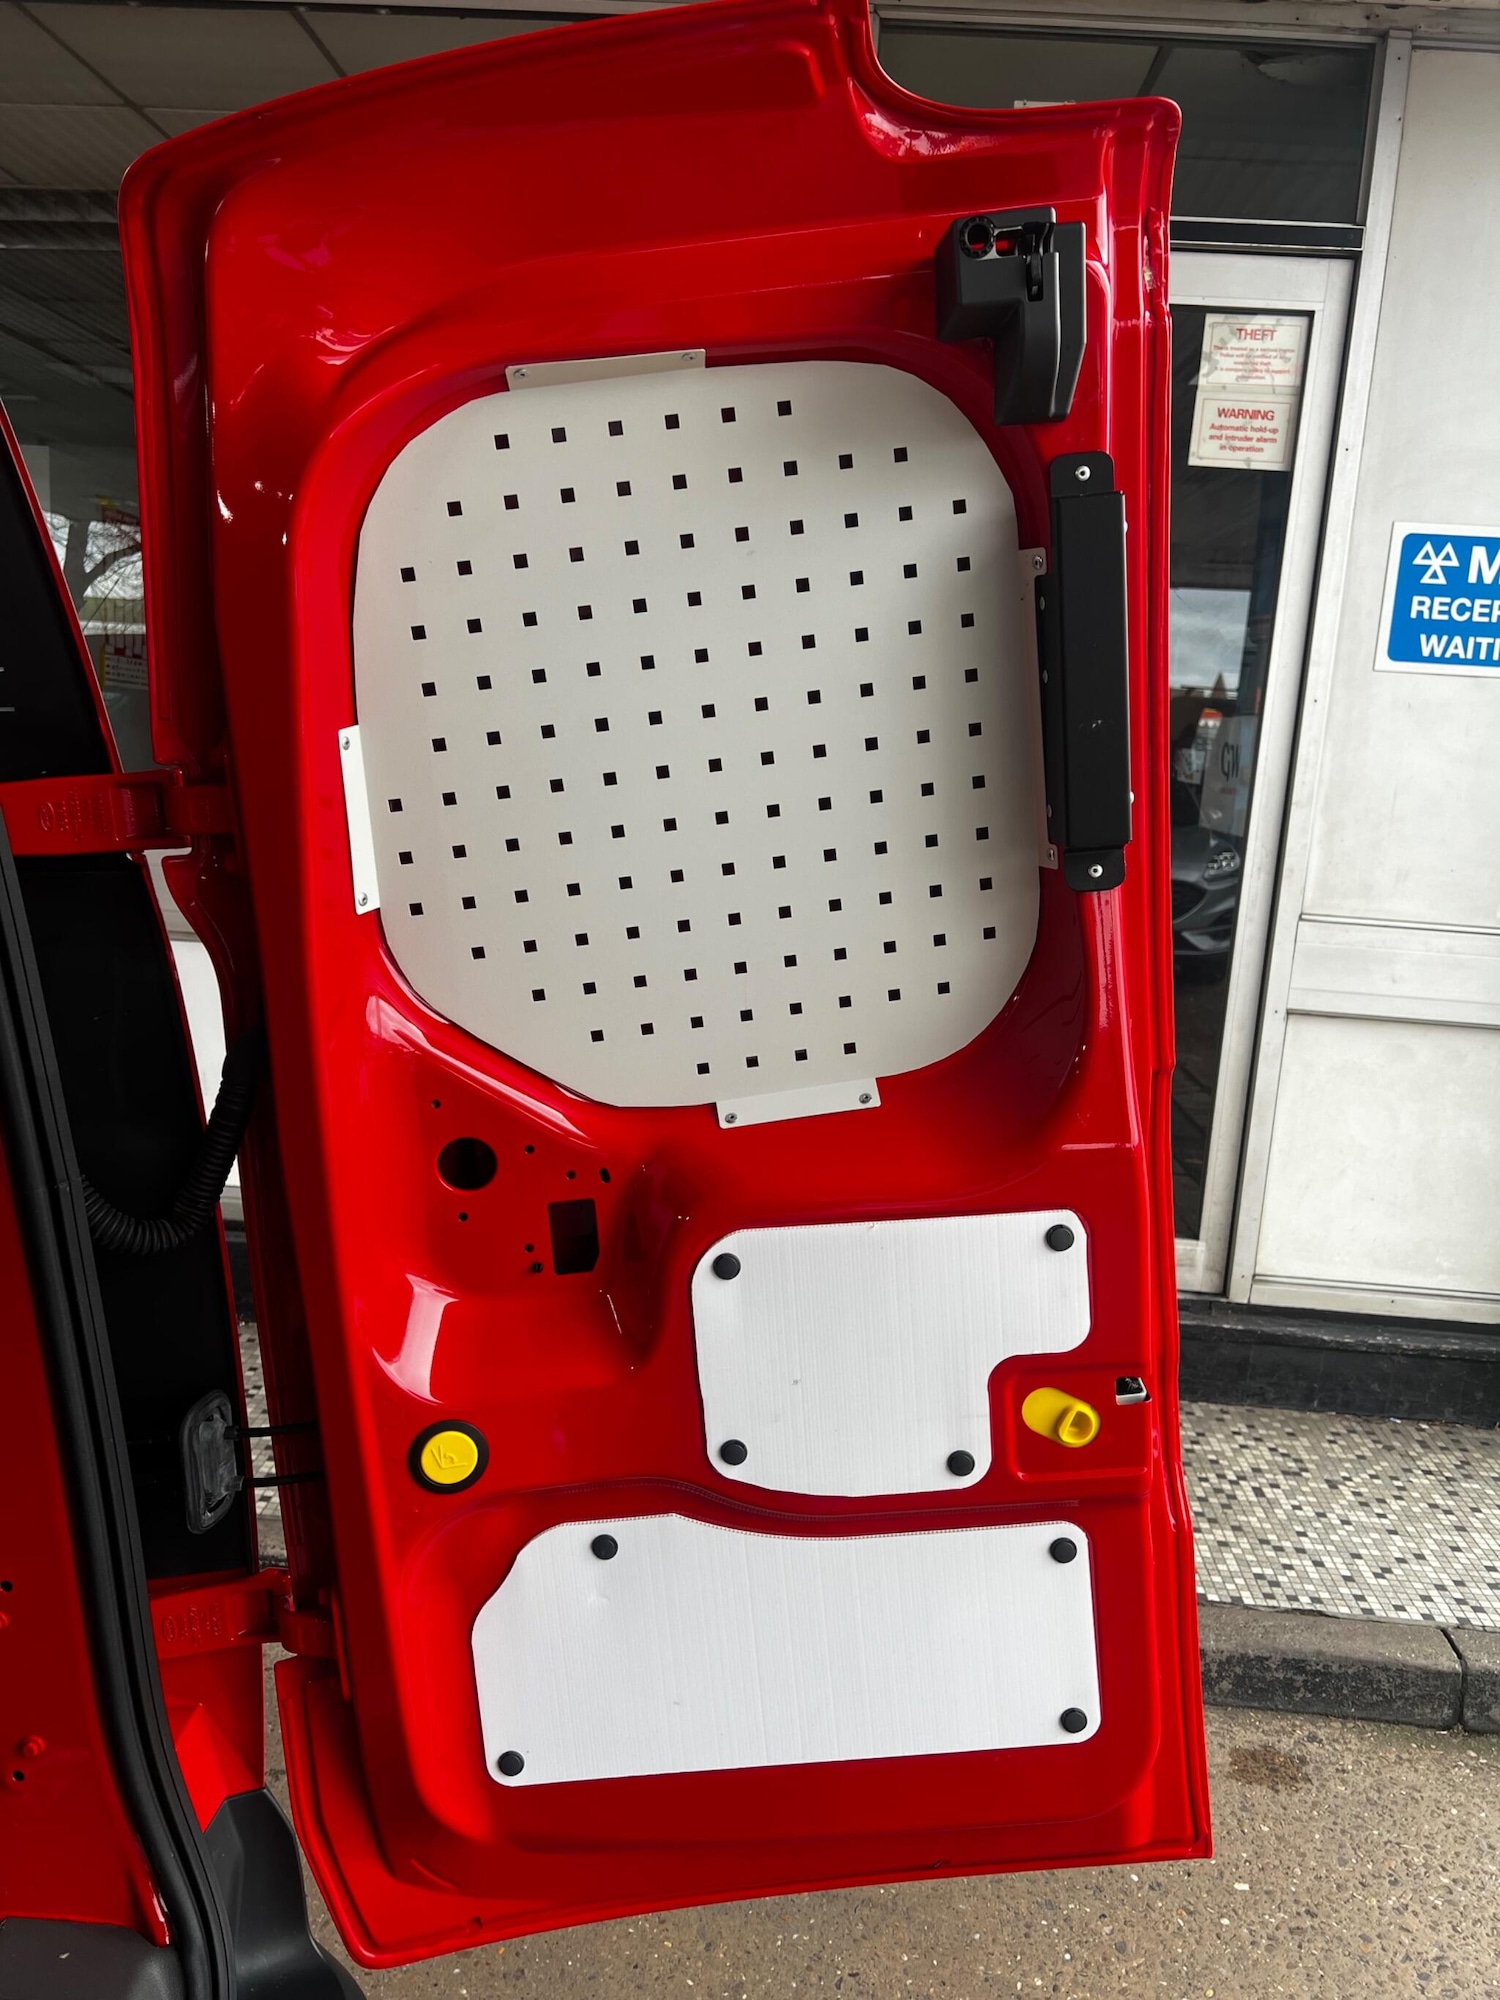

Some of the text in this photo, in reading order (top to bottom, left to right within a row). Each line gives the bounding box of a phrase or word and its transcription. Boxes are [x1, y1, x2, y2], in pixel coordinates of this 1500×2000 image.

[1236, 327, 1277, 341] THEFT
[1217, 407, 1275, 421] WARNING
[1209, 423, 1279, 435] Automatic hold-up
[1225, 434, 1254, 442] intruder
